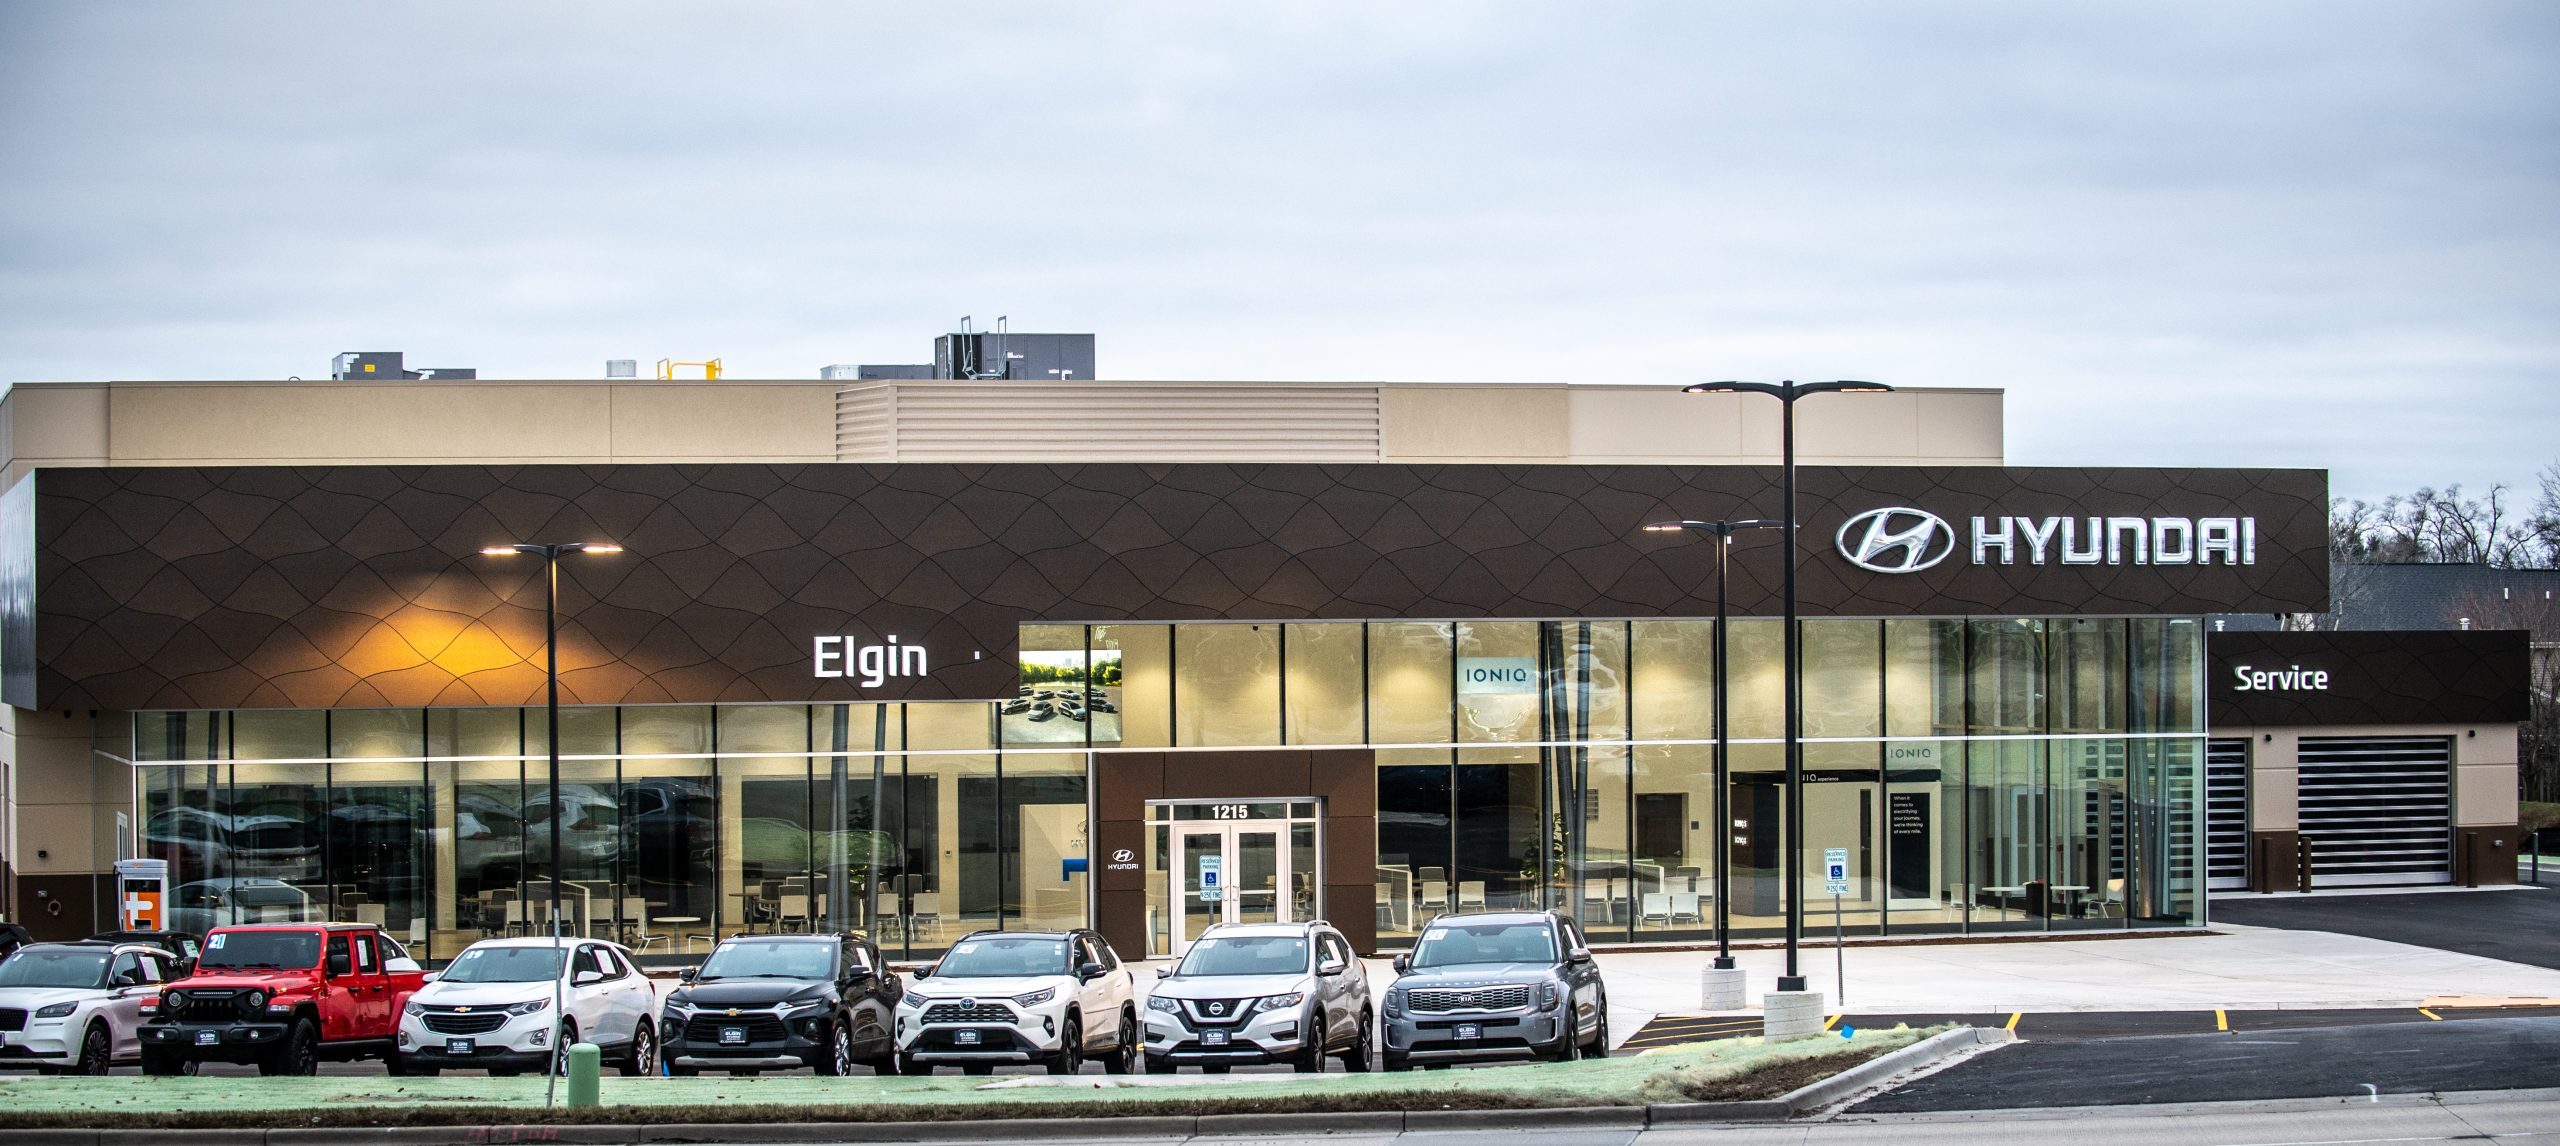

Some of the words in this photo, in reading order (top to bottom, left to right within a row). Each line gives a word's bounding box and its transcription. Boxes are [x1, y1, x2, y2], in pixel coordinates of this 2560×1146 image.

[1970, 515, 2256, 566] HYUNDAI
[814, 634, 927, 688] Elgin
[1466, 667, 1527, 683] IONIQ
[2234, 664, 2328, 691] Service
[1890, 747, 1932, 759] IONIQ
[1212, 804, 1248, 820] 1215
